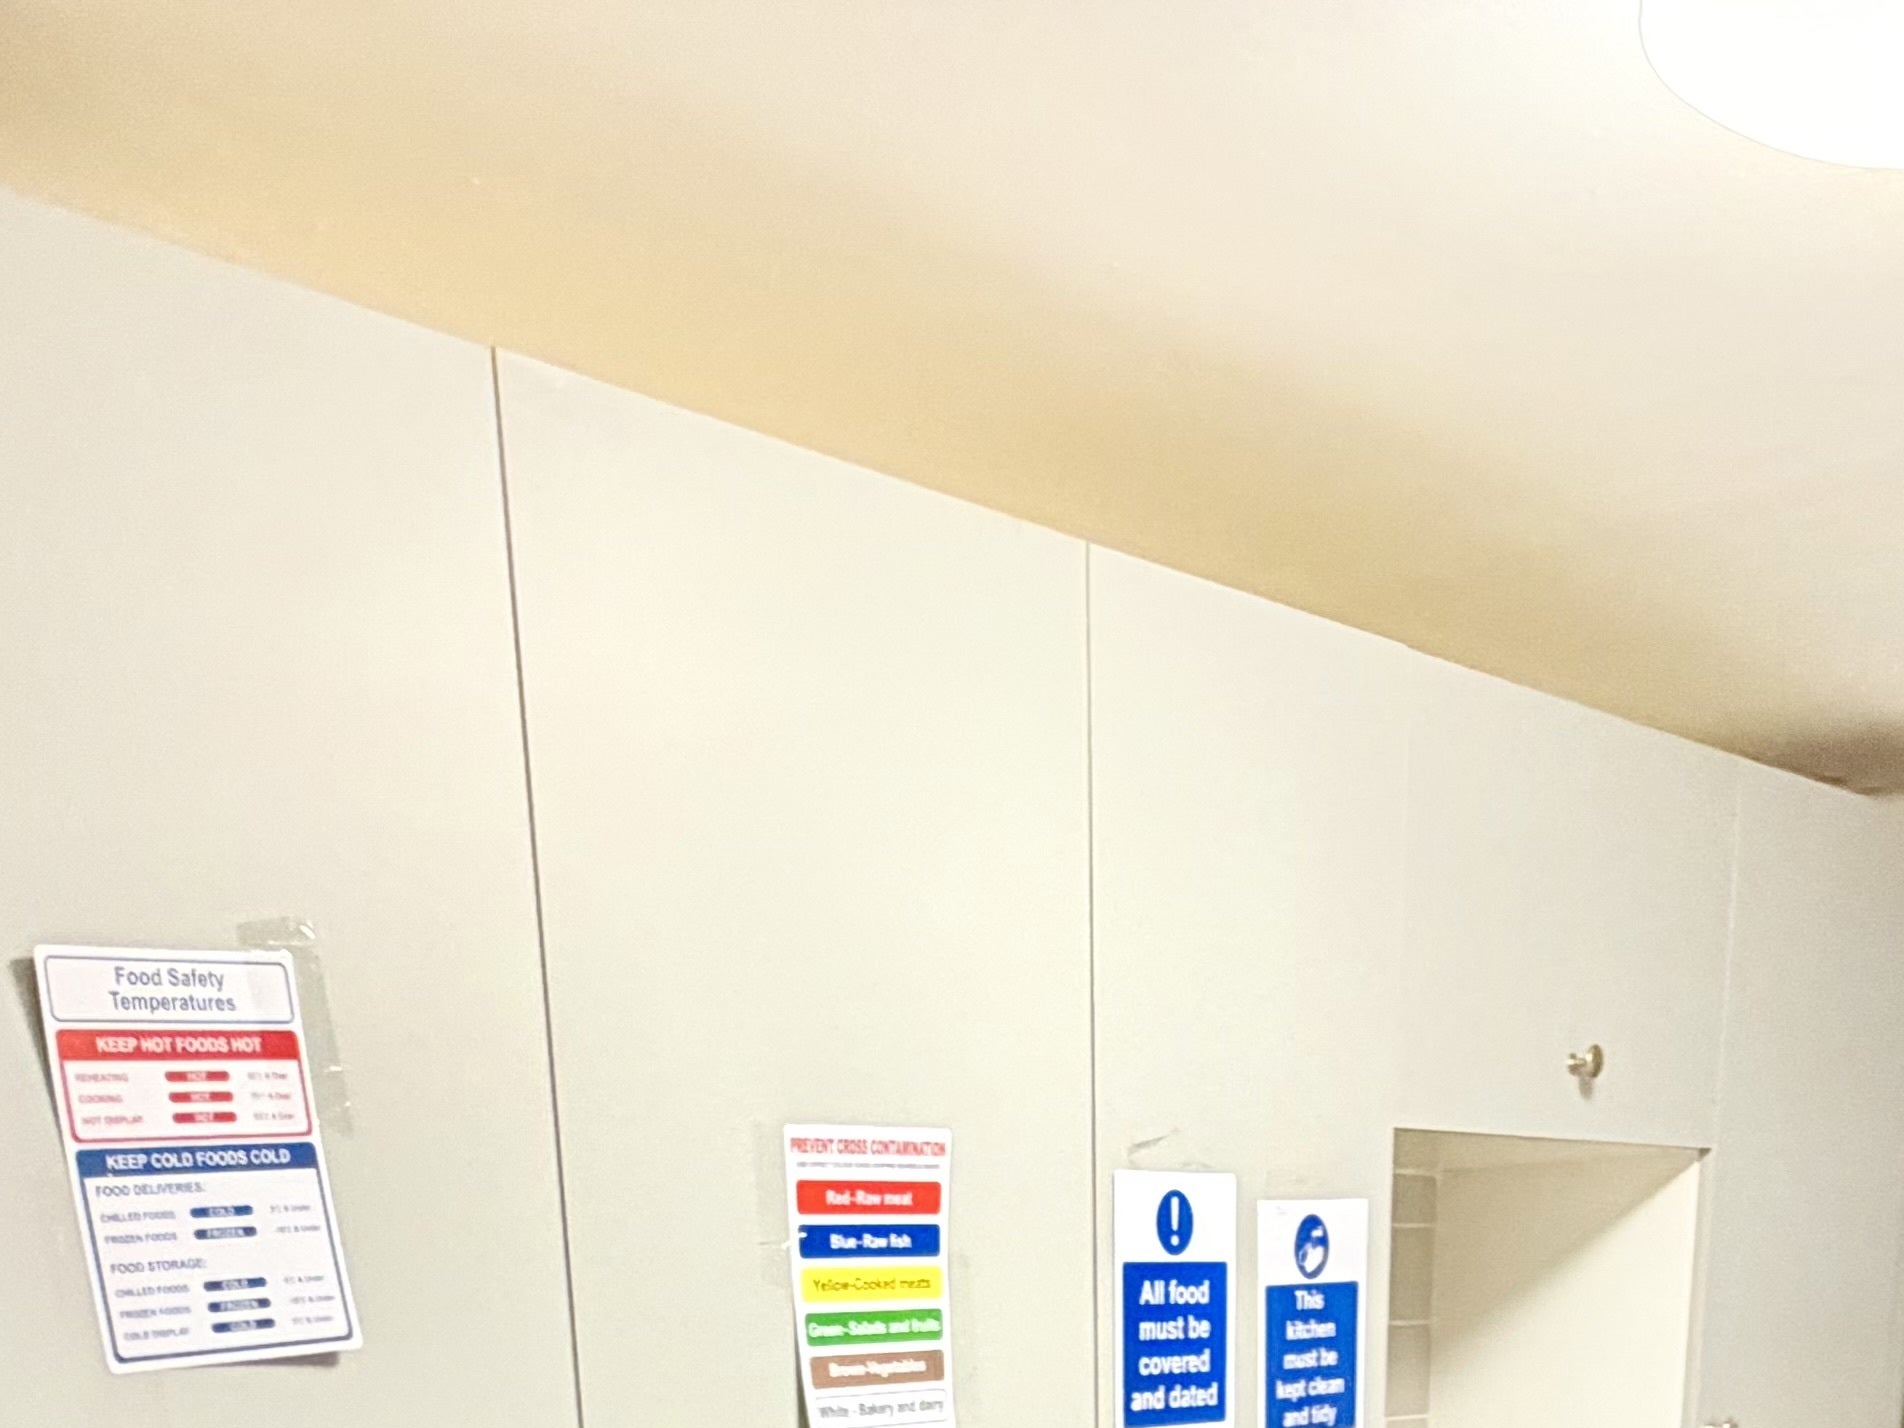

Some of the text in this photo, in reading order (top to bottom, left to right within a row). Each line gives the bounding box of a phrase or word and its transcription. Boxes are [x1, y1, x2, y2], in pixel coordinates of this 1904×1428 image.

[113, 965, 225, 993] Food Safety
[107, 989, 237, 1015] Temperatures
[96, 1036, 263, 1054] KEEP HOT FOODS HOT
[790, 1137, 947, 1156] PREVENT CROSS CONTAMINATION
[105, 1148, 292, 1171] KEEP COLD FOODS COLD
[95, 1183, 131, 1198] FOOD
[110, 1261, 145, 1275] FOOD
[1138, 1279, 1211, 1305] All food
[1294, 1289, 1325, 1311] This
[1138, 1314, 1212, 1342] must be
[1285, 1319, 1337, 1342] kitchen
[1138, 1348, 1211, 1376] covered
[1282, 1347, 1339, 1371] must be
[1130, 1381, 1219, 1412] and dated
[1275, 1376, 1346, 1403] kept clean
[1282, 1403, 1338, 1428] and tidy
